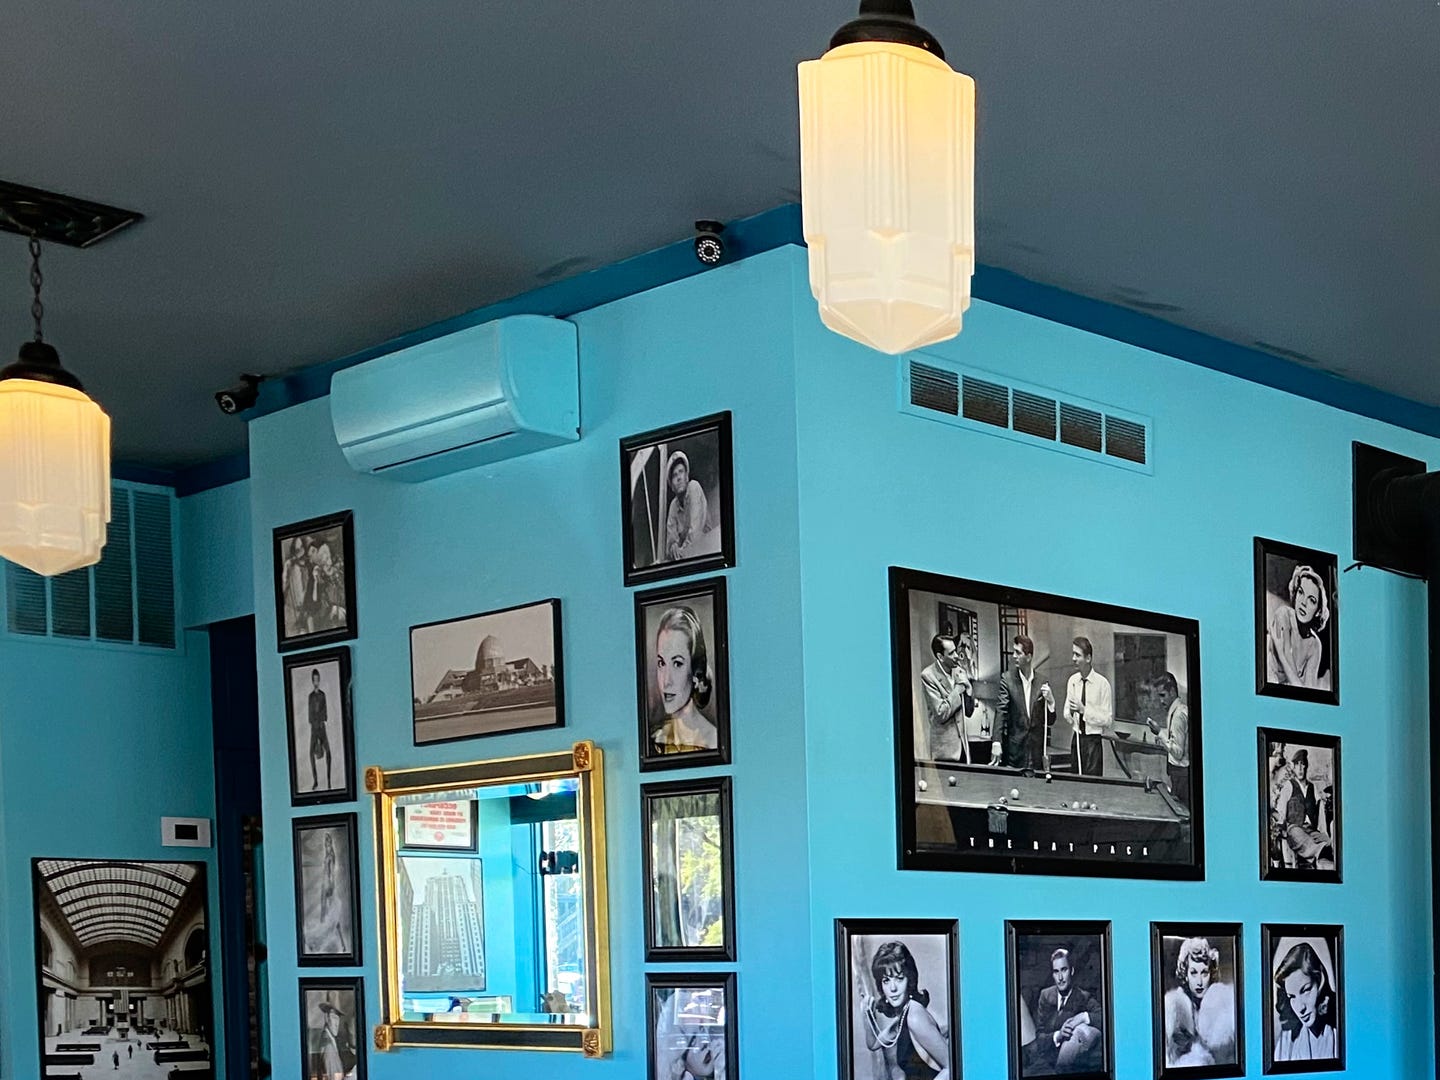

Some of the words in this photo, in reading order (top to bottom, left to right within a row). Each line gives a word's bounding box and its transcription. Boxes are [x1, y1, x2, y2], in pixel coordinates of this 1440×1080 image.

[969, 837, 1012, 849] THE
[1033, 840, 1074, 852] RAT
[1093, 844, 1148, 856] PACK
